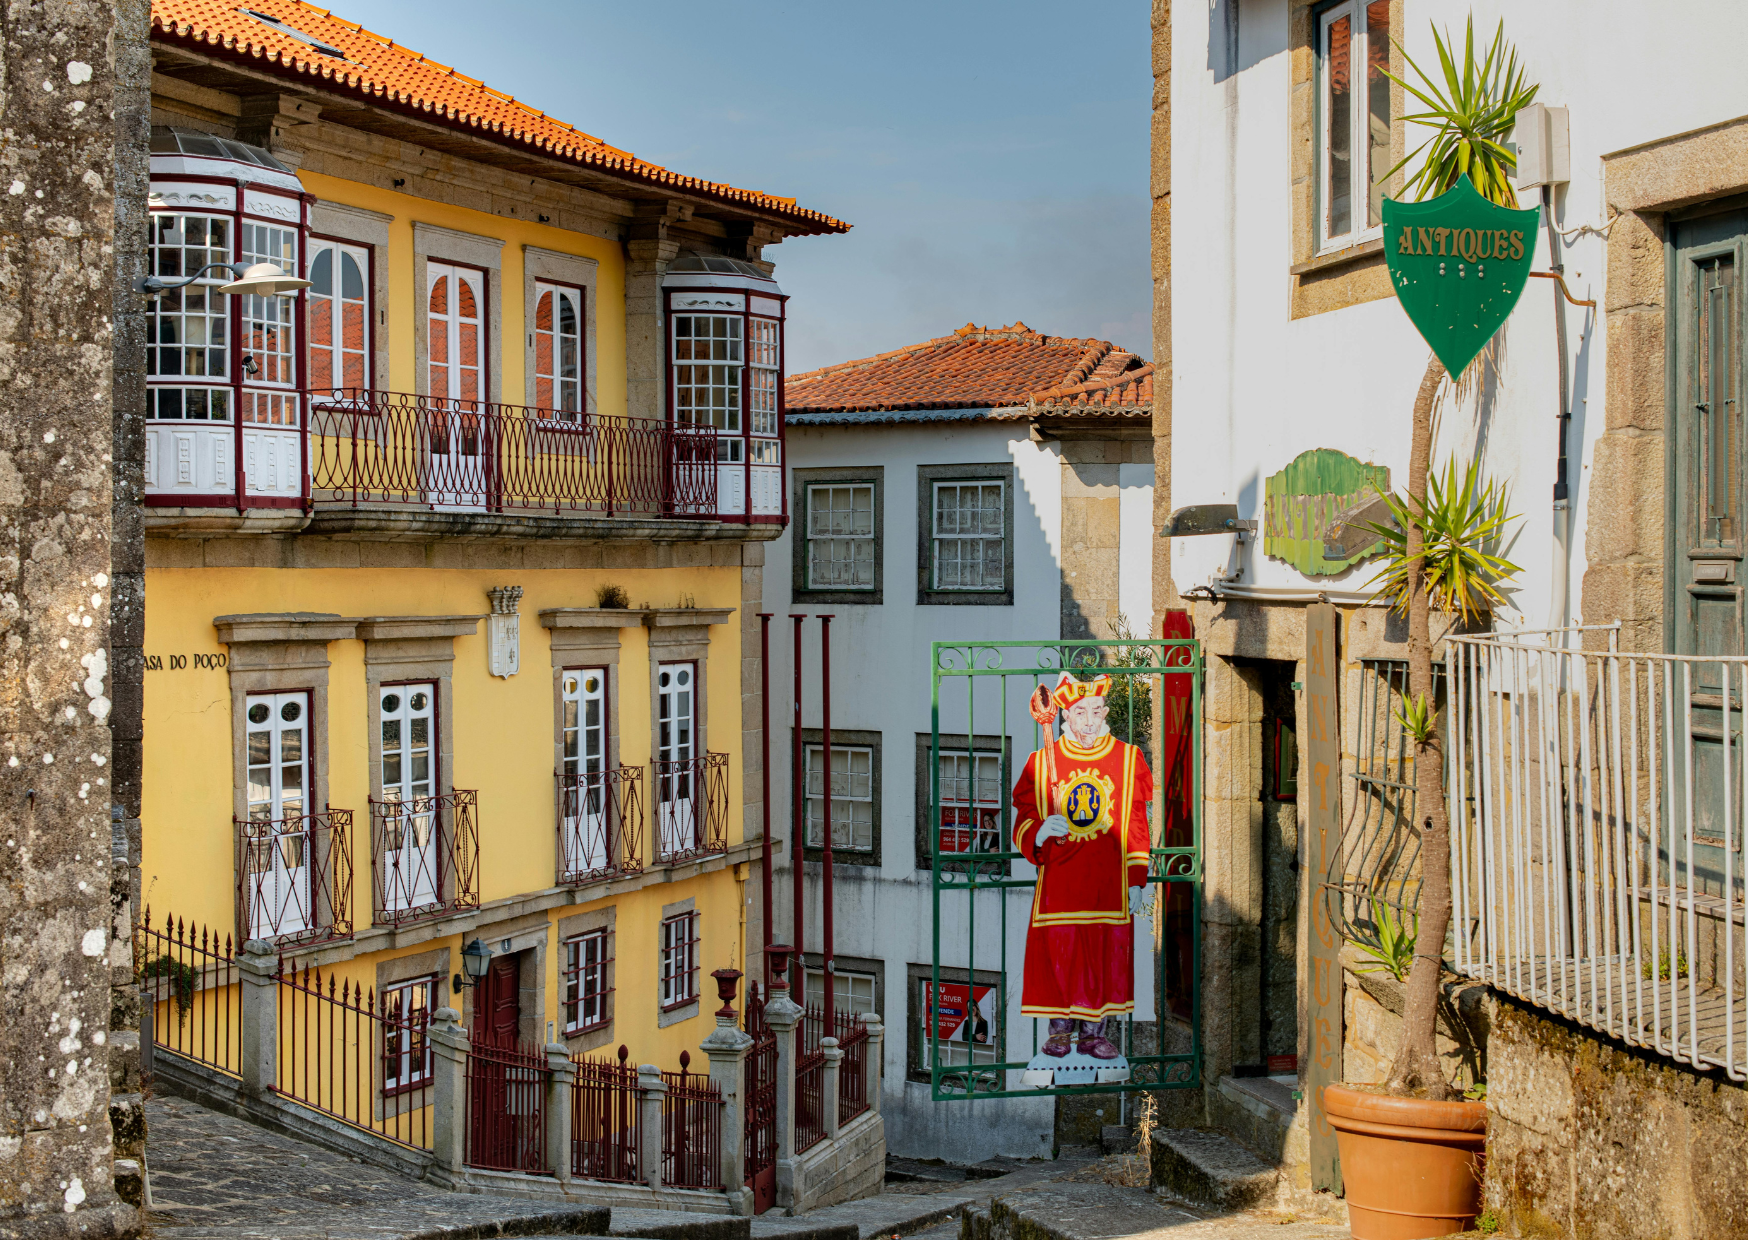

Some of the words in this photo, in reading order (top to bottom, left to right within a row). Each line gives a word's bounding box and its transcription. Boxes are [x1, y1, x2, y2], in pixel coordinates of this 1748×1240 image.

[1398, 226, 1525, 264] ANTIQUES
[169, 654, 187, 670] DO
[193, 653, 226, 671] POÇO
[943, 994, 962, 1003] RIVER
